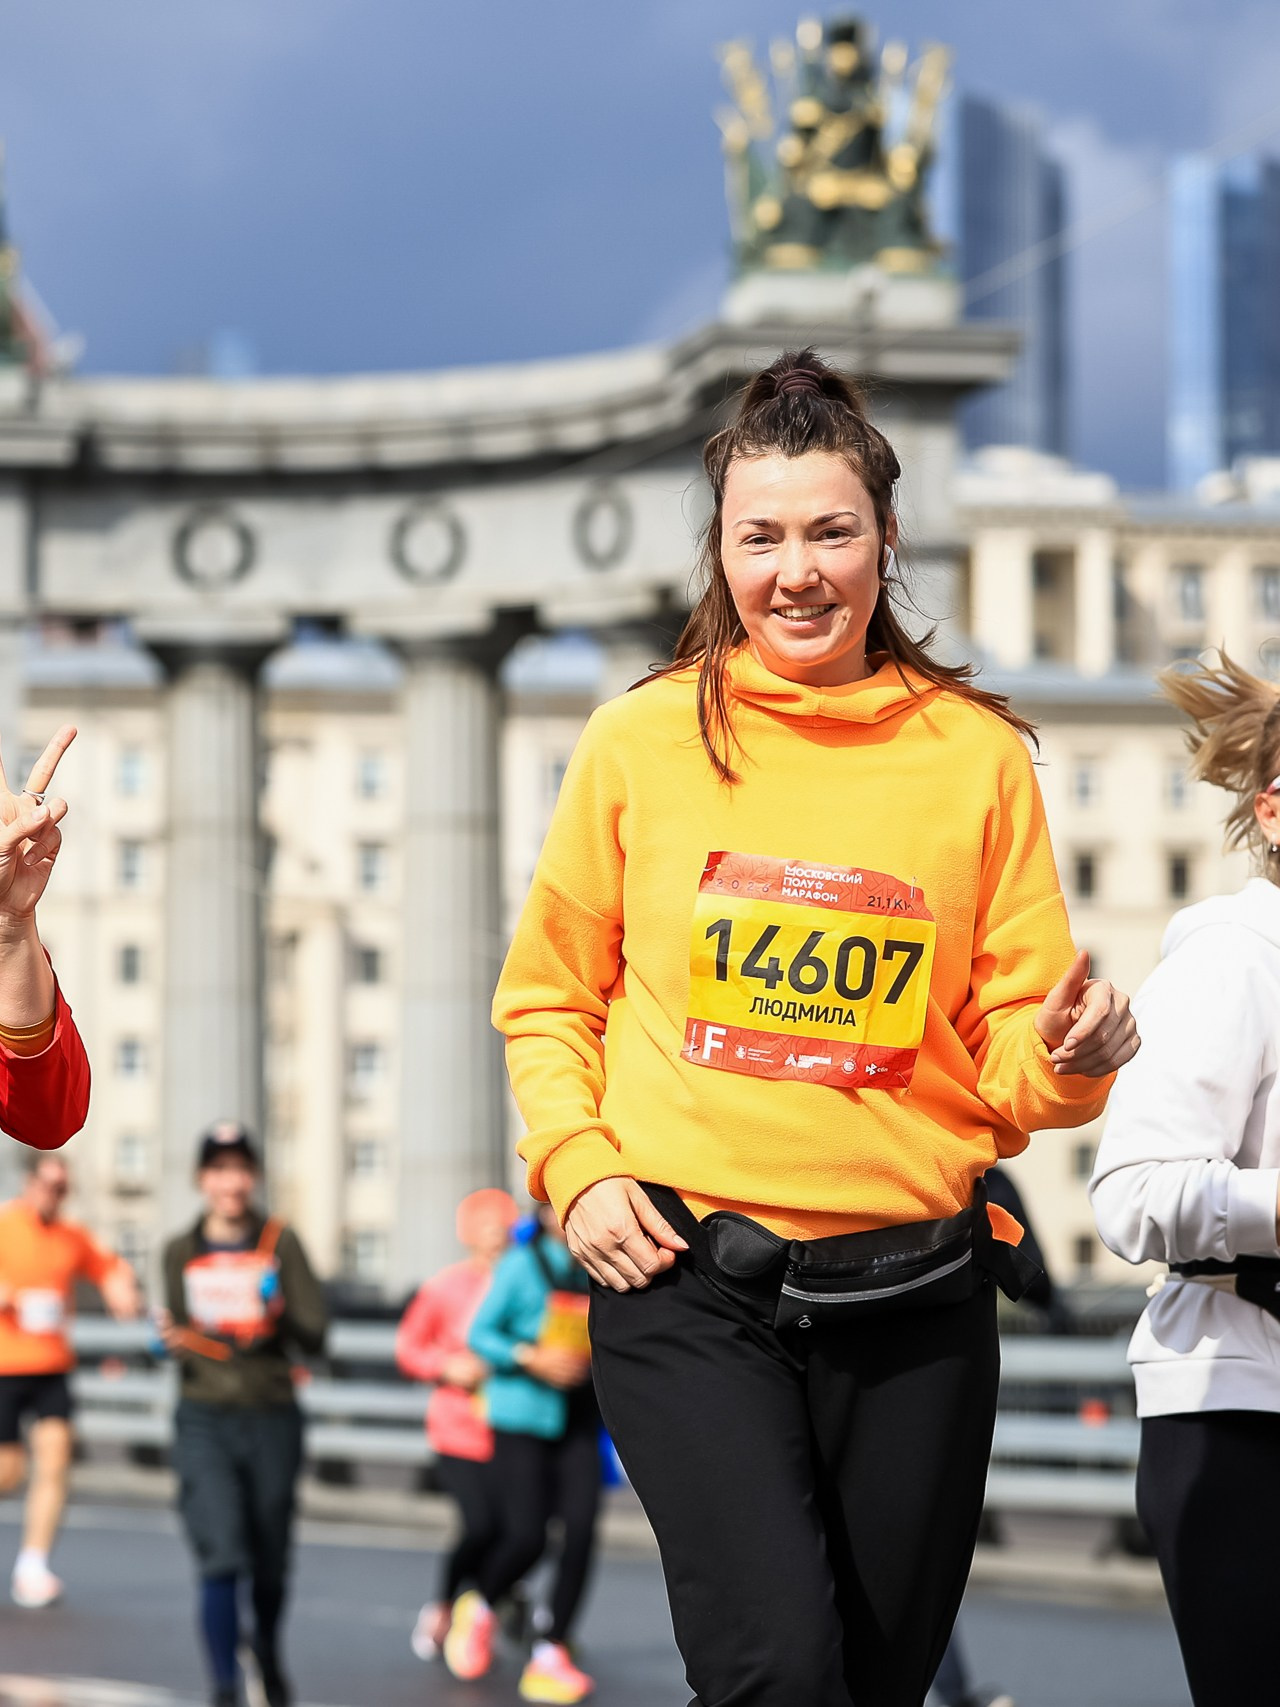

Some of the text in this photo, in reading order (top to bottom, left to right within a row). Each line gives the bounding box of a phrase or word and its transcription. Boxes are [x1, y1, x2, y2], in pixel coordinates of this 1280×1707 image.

[783, 877, 815, 889] ПОЛУ
[784, 865, 863, 885] МОСКОВСКИЙ
[715, 877, 770, 894] 2026
[781, 888, 839, 903] МАРАФОН
[867, 895, 891, 910] 21,1
[705, 918, 925, 1005] 14607
[748, 996, 857, 1027] ЛЮДМИЛА
[702, 1025, 727, 1060] F
